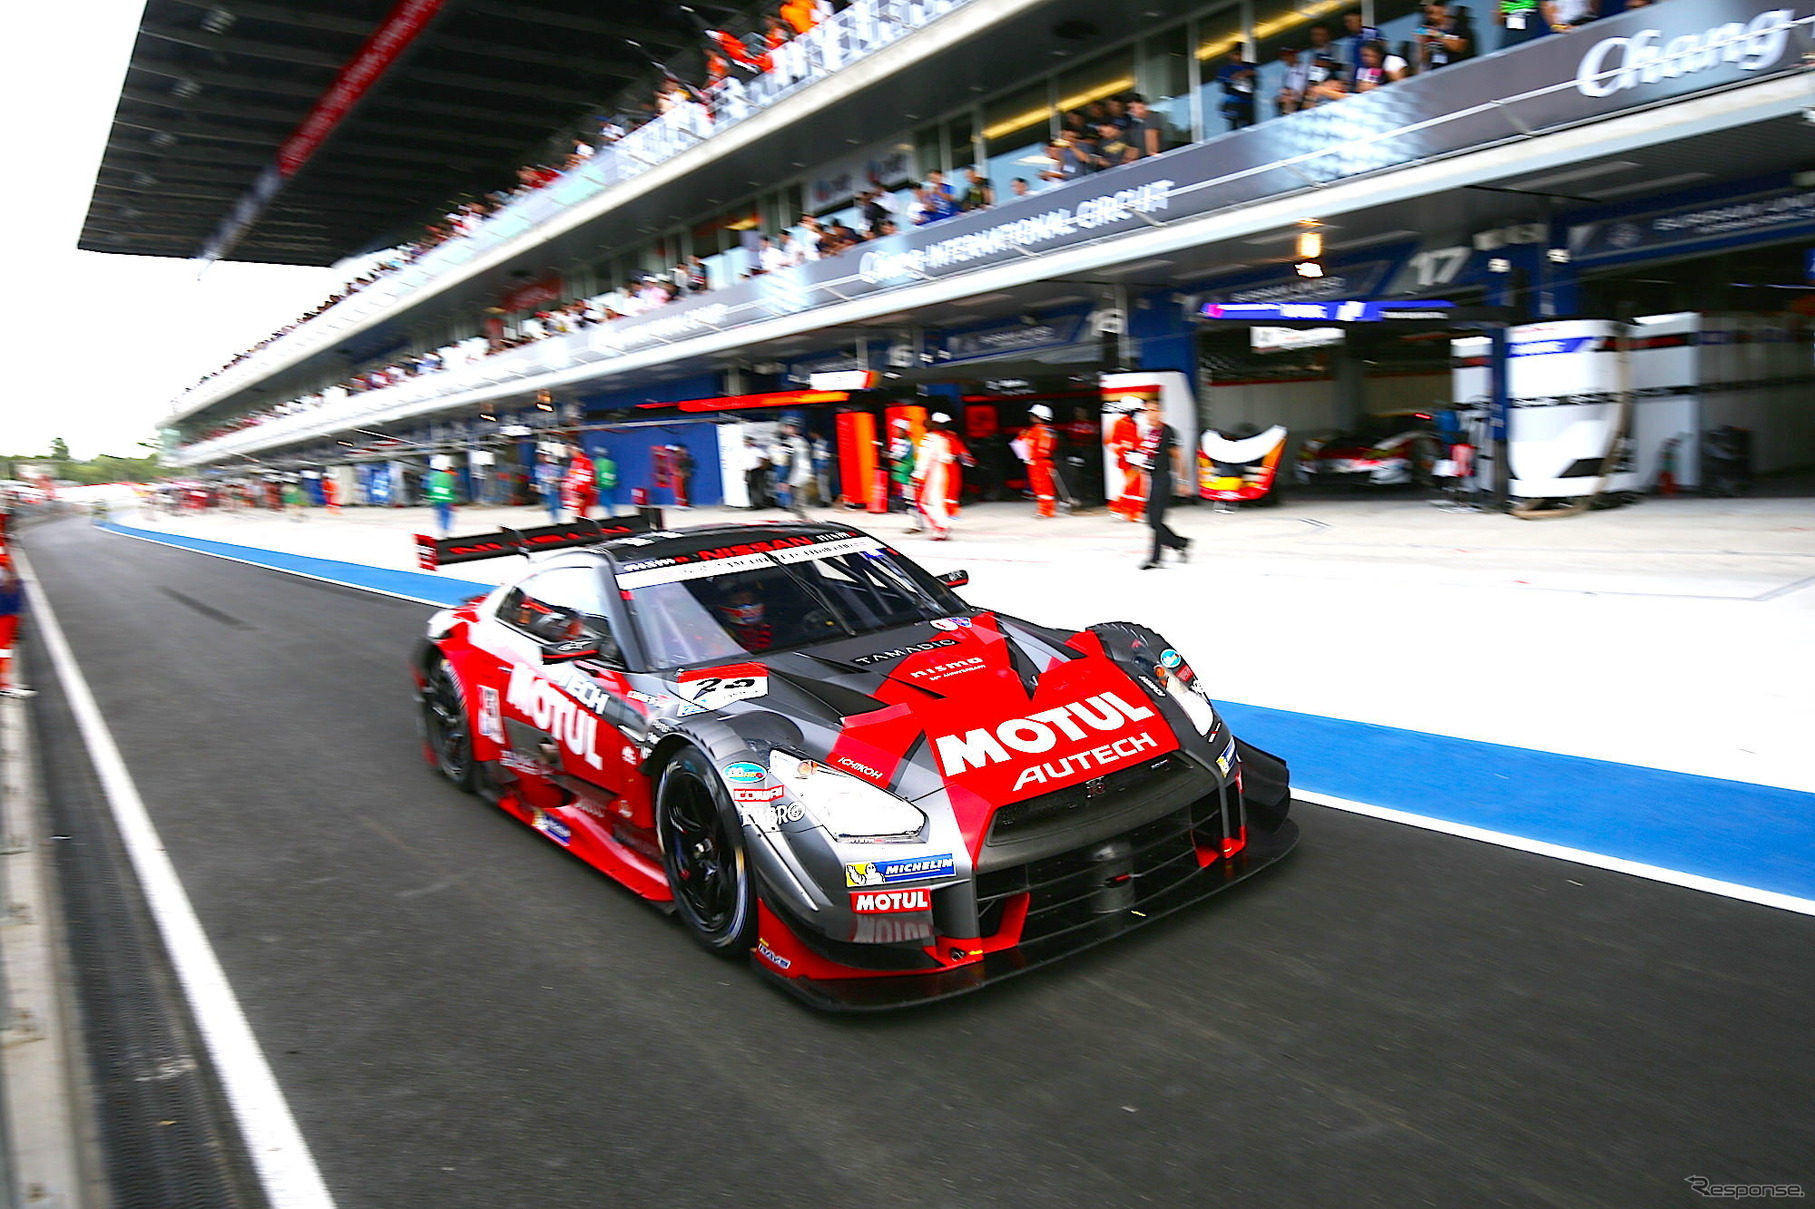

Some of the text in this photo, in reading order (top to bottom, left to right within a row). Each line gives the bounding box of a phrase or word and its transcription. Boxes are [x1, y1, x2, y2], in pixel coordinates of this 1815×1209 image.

[1576, 9, 1797, 98] Chang
[1075, 179, 1175, 229] CIRCUIT
[1409, 246, 1471, 286] 17
[697, 536, 814, 561] NISSAN
[855, 638, 956, 664] TAMADIC
[506, 661, 603, 771] MOTUL
[934, 692, 1155, 777] MOTUL
[837, 757, 883, 780] ICHIKOH
[1013, 732, 1158, 791] AUTECH
[885, 858, 953, 875] MICHELIN
[856, 891, 928, 911] MOTUL
